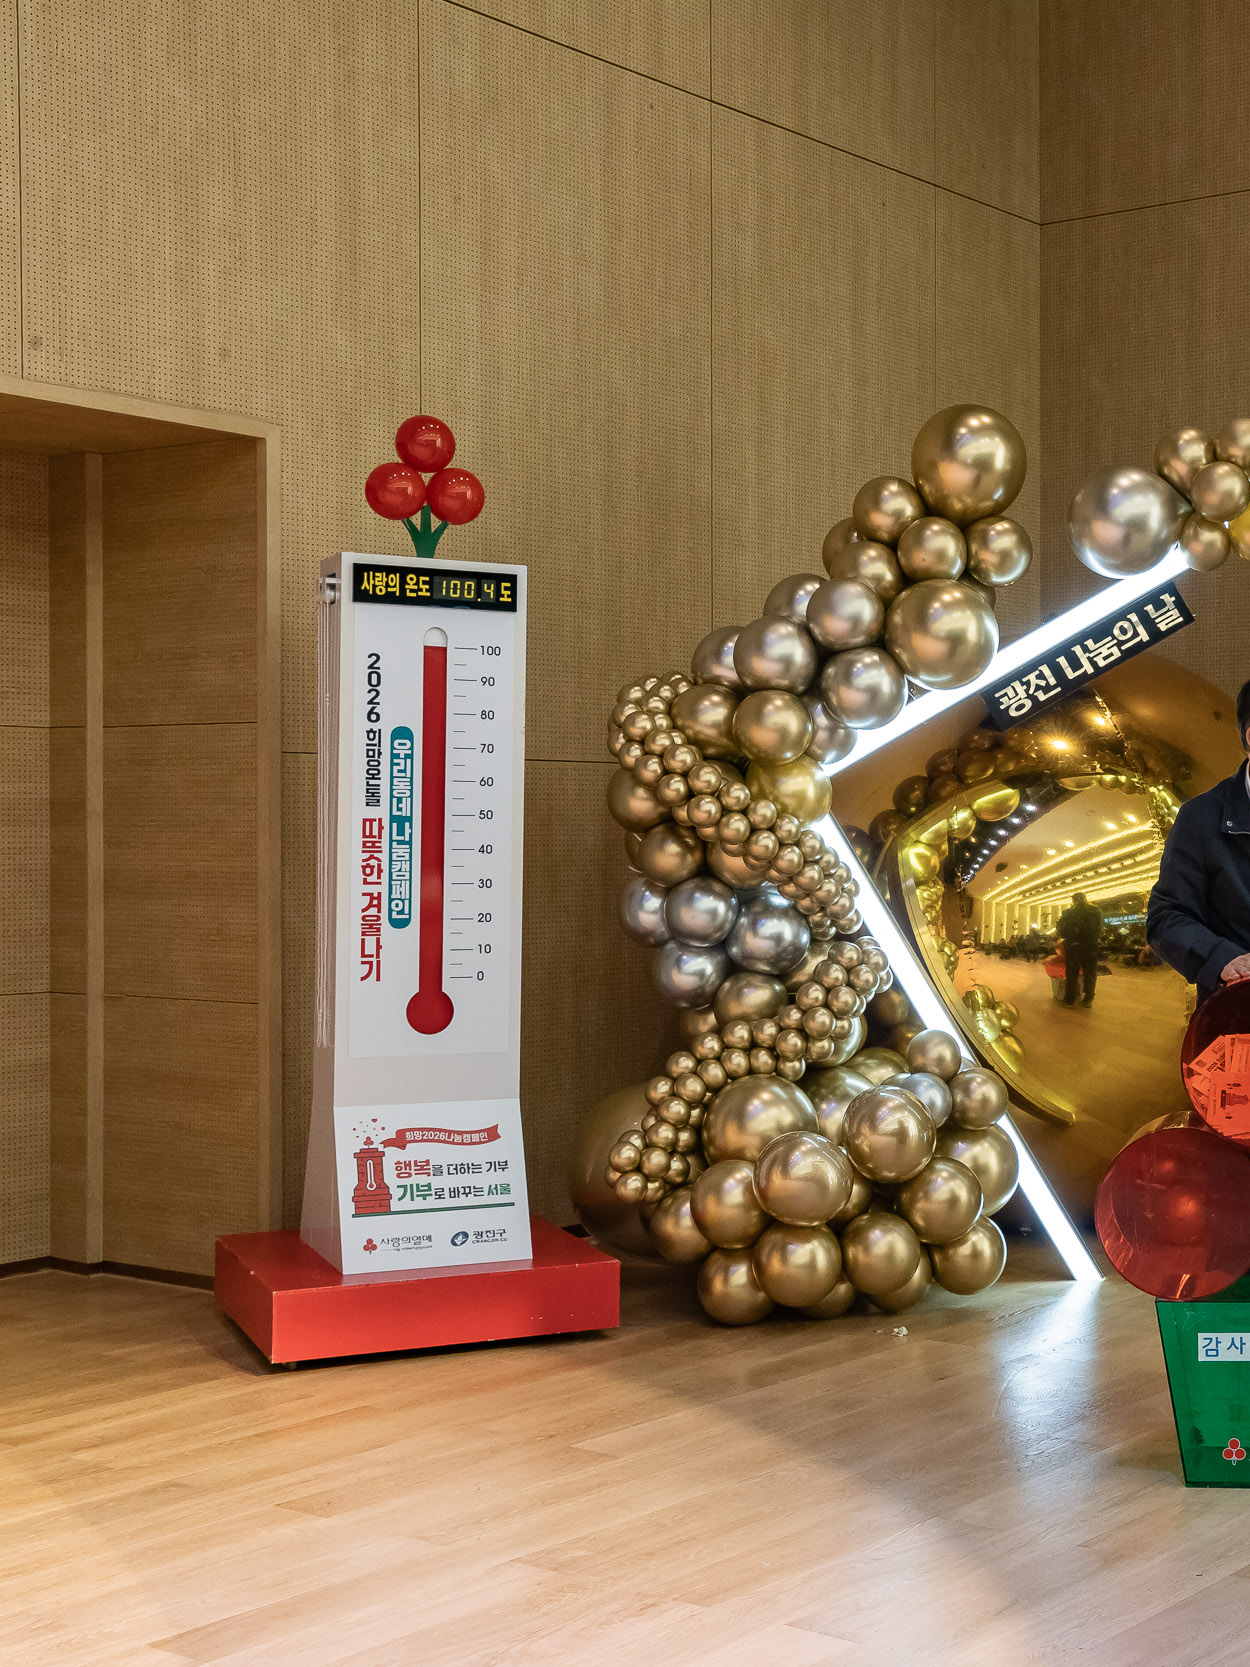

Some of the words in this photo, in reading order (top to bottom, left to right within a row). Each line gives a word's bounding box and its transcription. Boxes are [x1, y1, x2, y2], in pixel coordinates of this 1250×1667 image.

[361, 571, 400, 597] 사랑의
[405, 574, 430, 597] 온도
[442, 580, 494, 602] 100.4
[500, 582, 512, 602] 도
[480, 645, 501, 656] 100
[994, 664, 1062, 717] 광진
[1056, 612, 1150, 680] 나눔의
[1144, 593, 1184, 632] 날
[481, 676, 495, 687] 90
[366, 653, 381, 723] 2026
[480, 709, 495, 720] 80
[480, 743, 495, 754] 70
[365, 728, 382, 807] 희망온돌
[392, 738, 412, 817] 우리동네
[479, 777, 494, 787] 60
[478, 810, 493, 820] 50
[361, 817, 384, 886] 따뜻한
[478, 844, 493, 854] 40
[390, 821, 412, 919] 나눔캠페인
[477, 878, 493, 889] 30
[477, 912, 492, 923] 20
[360, 891, 383, 982] 겨울나기
[477, 944, 492, 954] 10
[476, 970, 484, 981] 0
[405, 1131, 488, 1143] 희망2026나눔캠페인
[394, 1159, 444, 1179] 행복을
[447, 1162, 483, 1176] 더하는
[485, 1160, 509, 1173] 기부
[397, 1182, 445, 1201] 기부로
[448, 1185, 484, 1199] 바꾸는
[487, 1183, 511, 1197] 서울
[473, 1228, 507, 1240] 광진구
[380, 1234, 432, 1247] 사랑의열매
